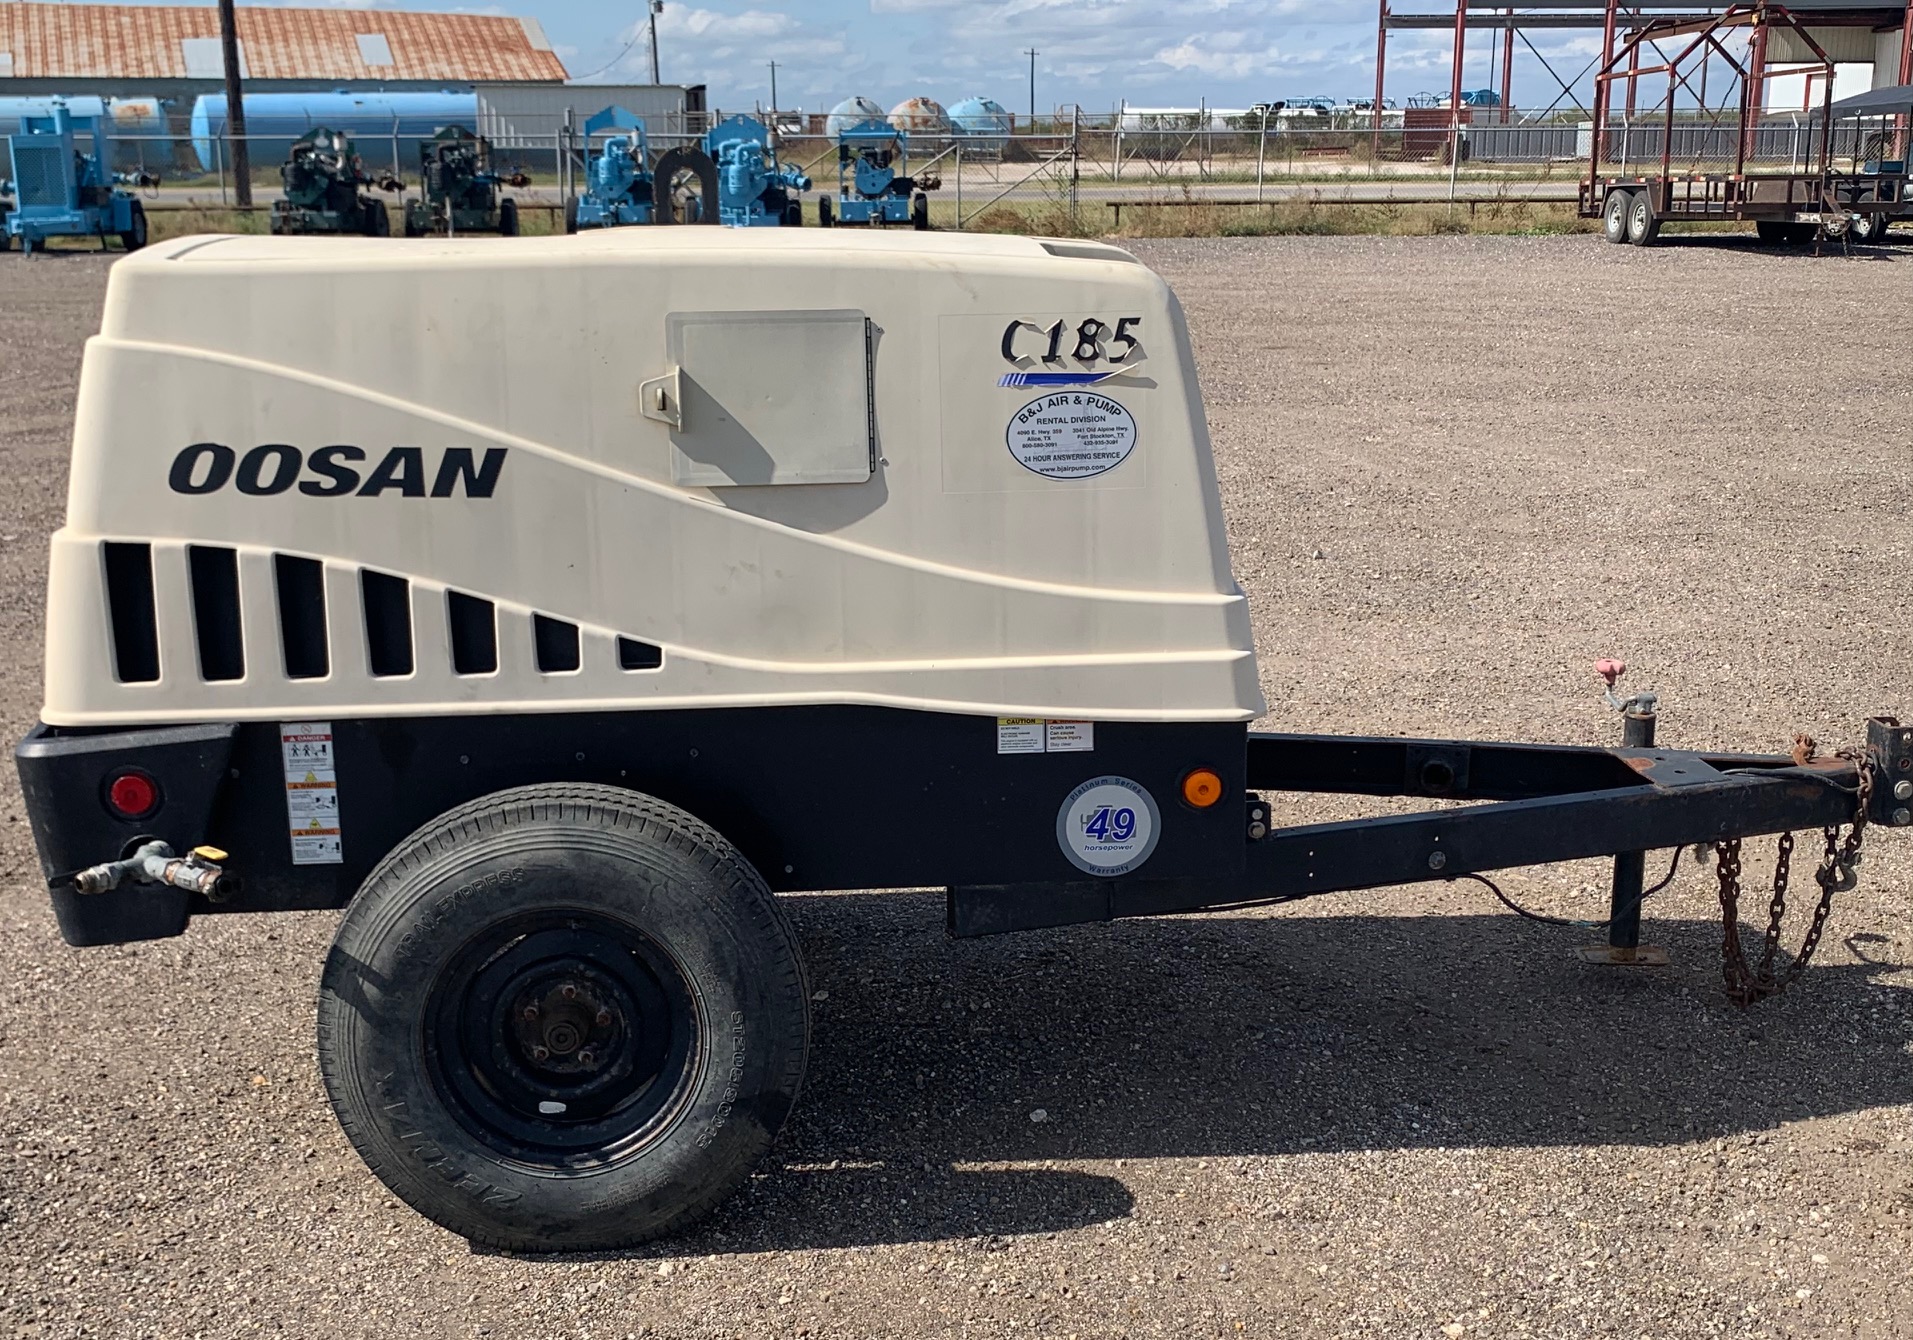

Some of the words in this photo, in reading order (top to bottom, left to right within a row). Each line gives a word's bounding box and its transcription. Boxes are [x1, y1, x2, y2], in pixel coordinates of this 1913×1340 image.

[1001, 317, 1142, 364] C185
[1018, 402, 1043, 424] B&J
[1047, 395, 1069, 408] AIR
[1073, 395, 1082, 405] &
[1086, 396, 1122, 416] PUMP
[1036, 417, 1068, 425] RENTAL
[1071, 415, 1106, 423] DIVISION
[1053, 453, 1092, 461] ANSWERING
[168, 442, 508, 498] OOSAN
[1040, 465, 1106, 473] www.bjairpump.com
[1070, 778, 1108, 800] Platinum
[1115, 778, 1142, 795] Series
[1085, 807, 1136, 842] 49
[1084, 844, 1133, 852] horsepower
[1088, 864, 1129, 875] Warranty
